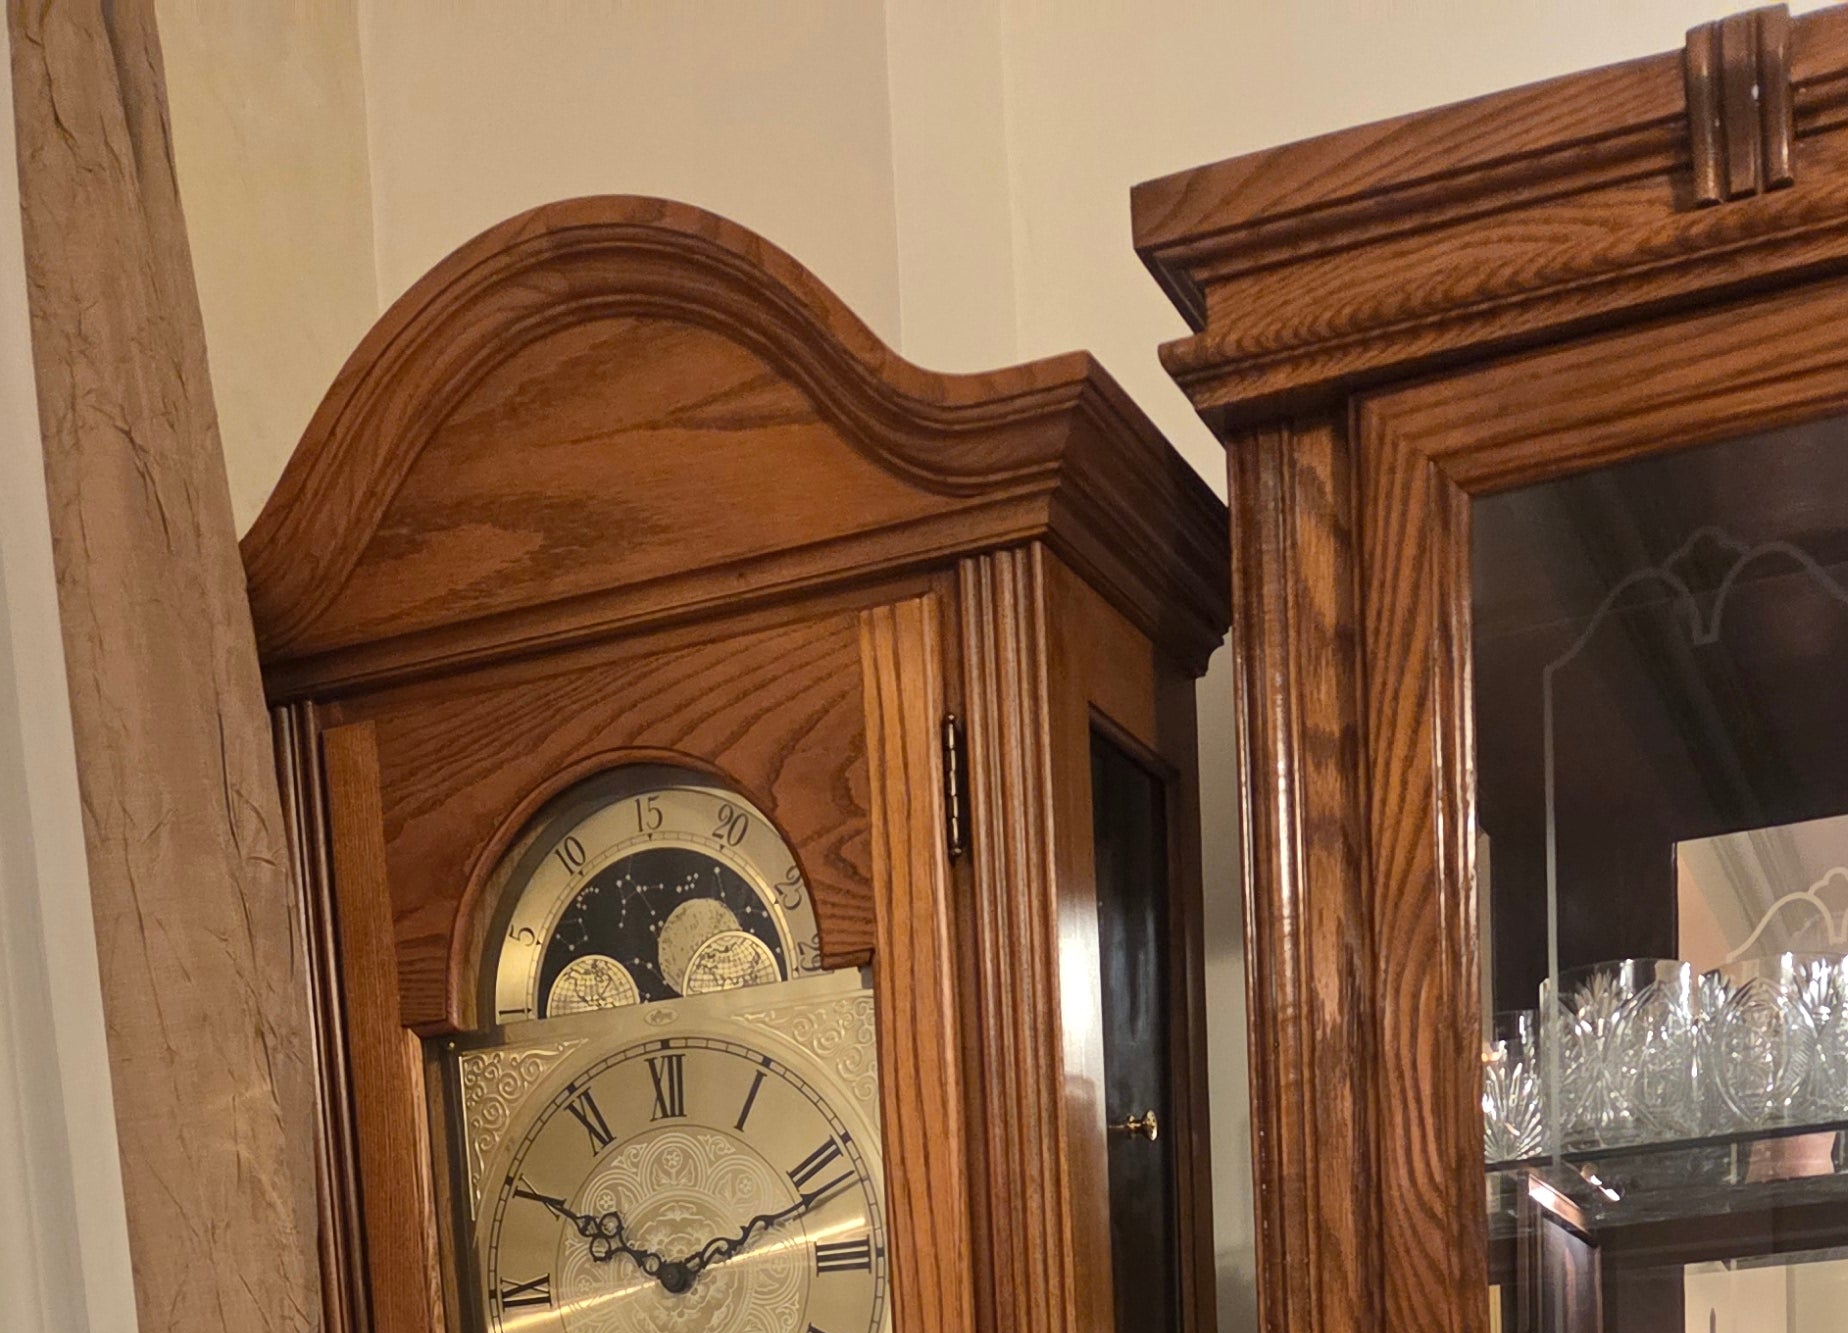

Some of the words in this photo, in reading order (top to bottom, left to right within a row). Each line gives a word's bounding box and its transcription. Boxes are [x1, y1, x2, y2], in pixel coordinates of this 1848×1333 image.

[636, 795, 663, 833] 15
[712, 803, 748, 847] 20
[554, 836, 586, 876] 10
[509, 924, 536, 947] 5
[645, 1053, 688, 1122] XII
[734, 1070, 767, 1132] I
[565, 1087, 617, 1157] XI
[786, 1135, 843, 1192] II
[513, 1173, 566, 1221] X
[815, 1234, 871, 1277] III
[500, 1273, 552, 1311] IX
